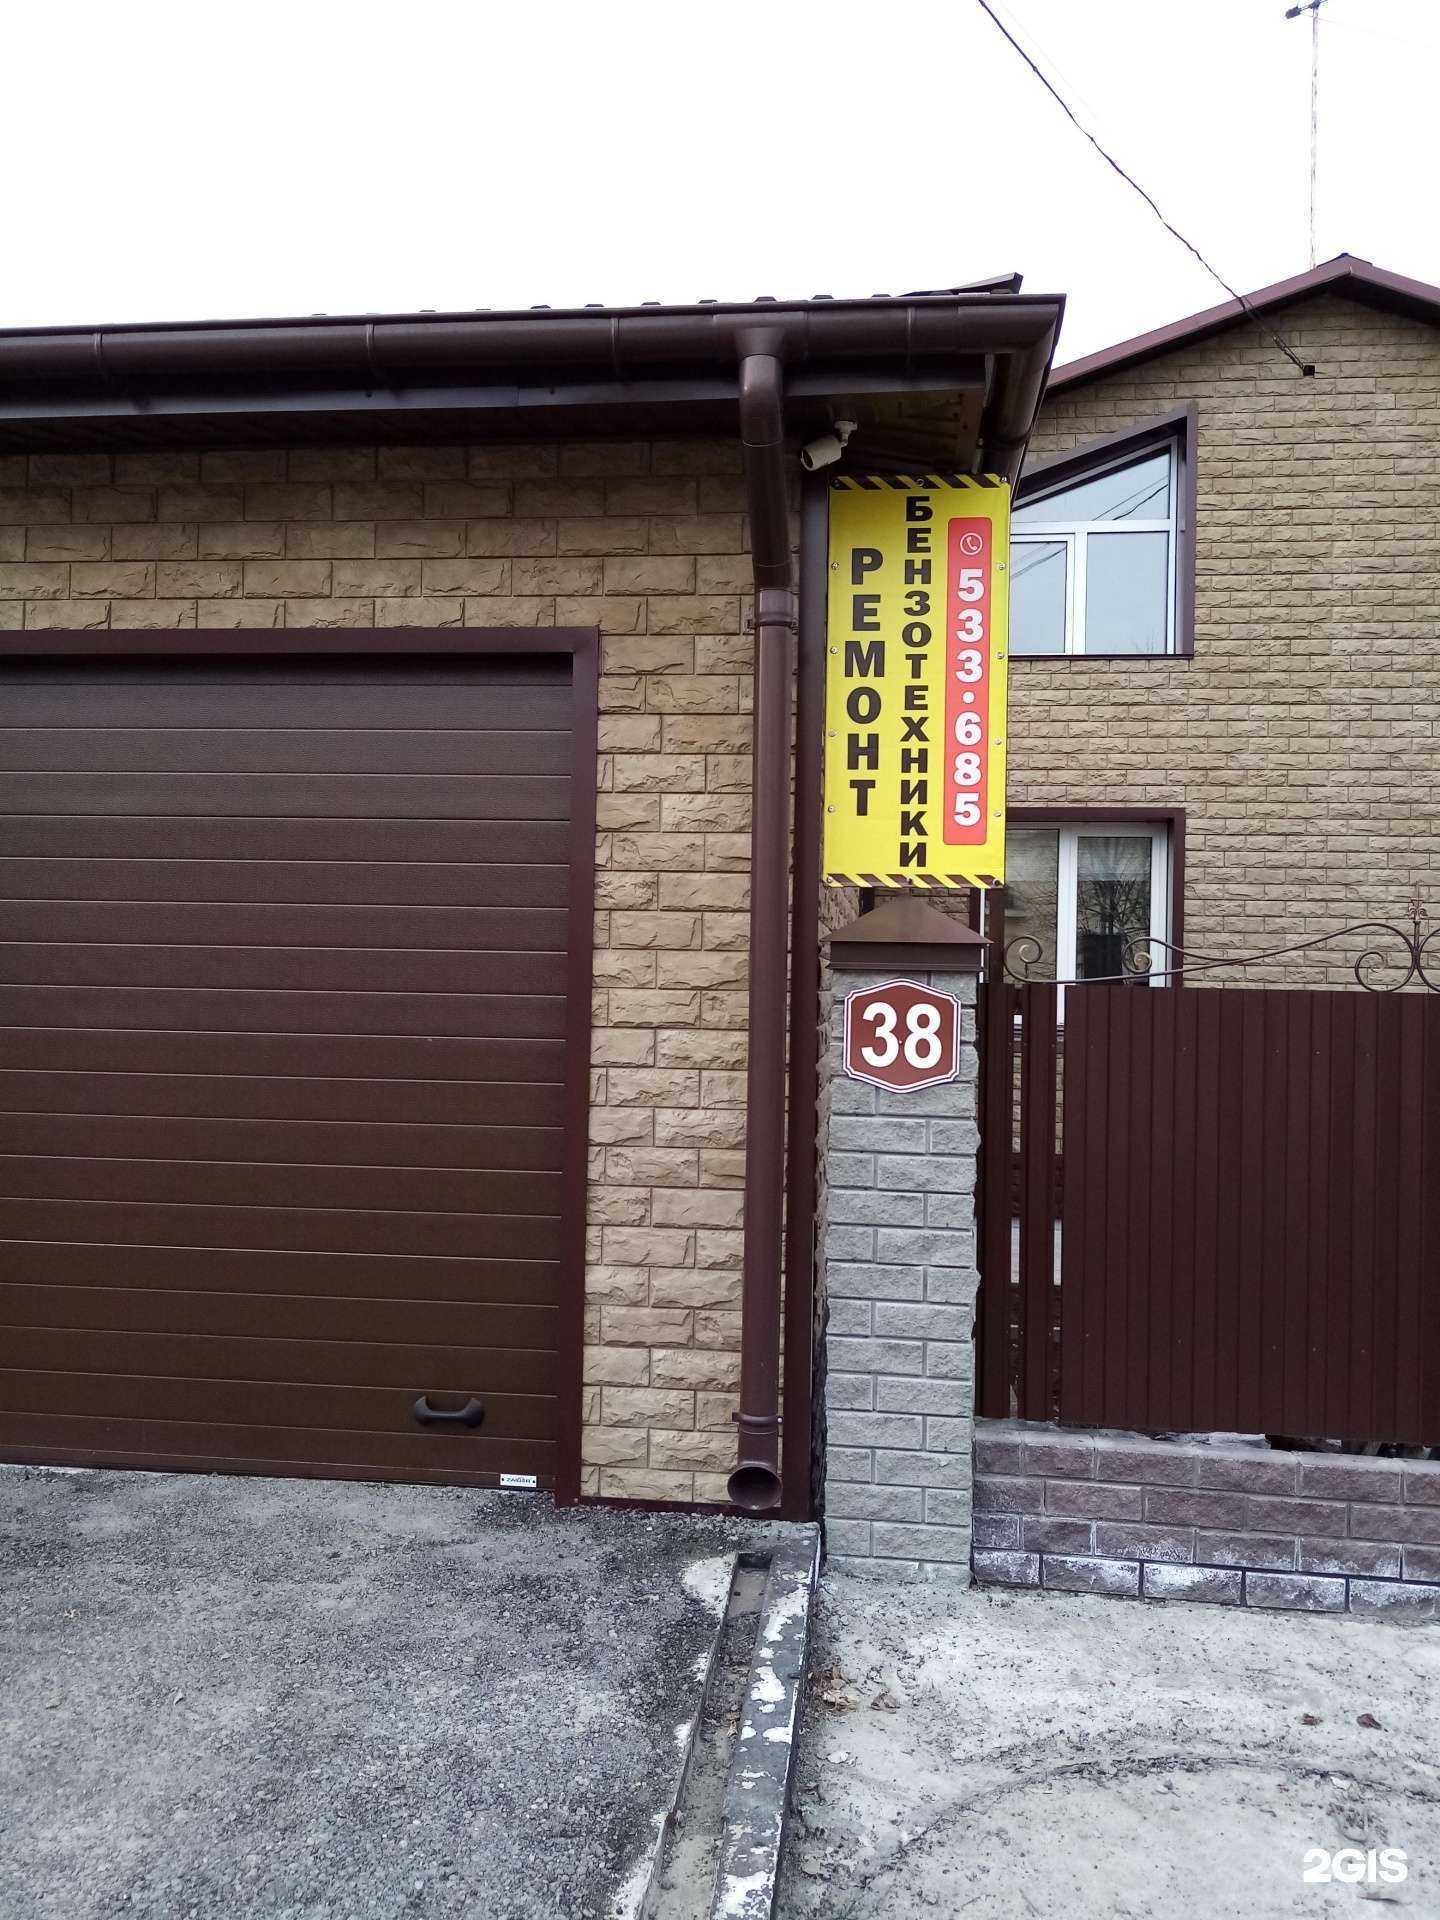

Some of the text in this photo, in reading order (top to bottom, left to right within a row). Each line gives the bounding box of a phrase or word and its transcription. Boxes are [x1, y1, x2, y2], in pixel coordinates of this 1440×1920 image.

[844, 547, 886, 816] РЕМОНТ
[899, 495, 933, 868] БЕНЗОТЕХНИКИ
[861, 1001, 942, 1069] 38
